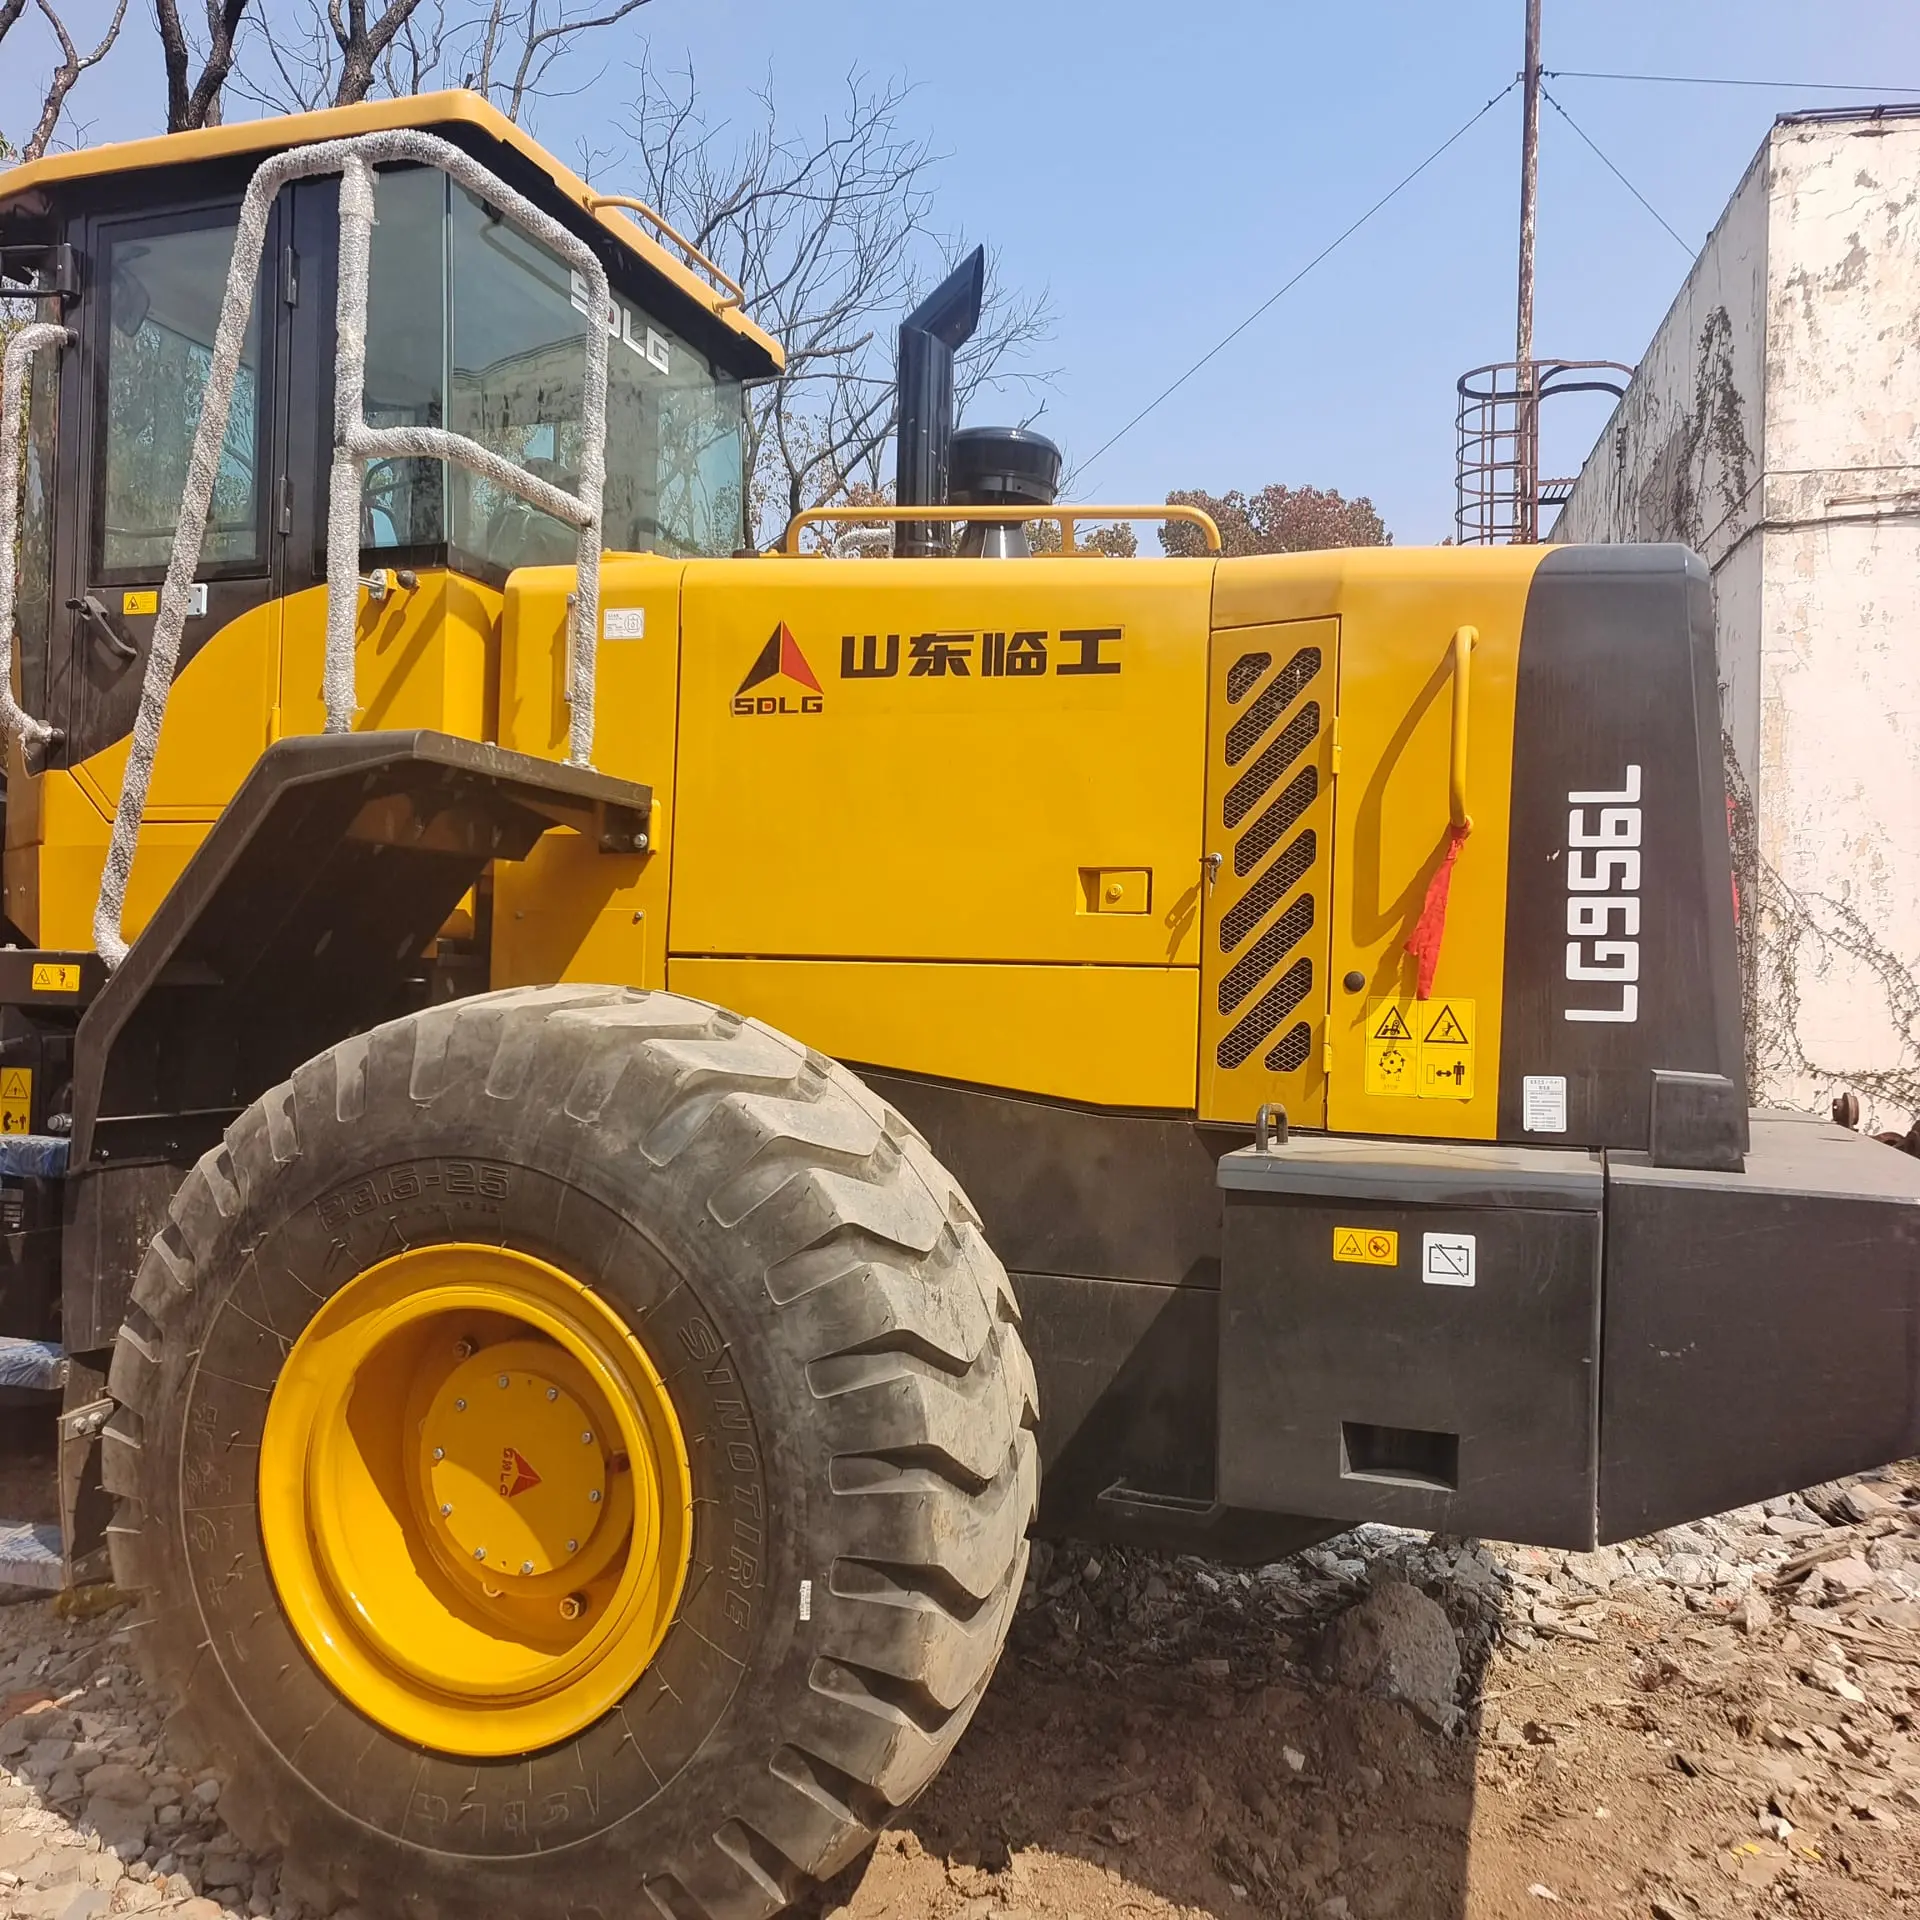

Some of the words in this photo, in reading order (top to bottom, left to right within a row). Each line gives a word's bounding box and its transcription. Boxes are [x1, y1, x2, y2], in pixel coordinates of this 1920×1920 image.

[840, 628, 1122, 679] 山东临工
[734, 696, 823, 715] SDLG
[1564, 765, 1642, 1022] LG956L
[315, 1162, 509, 1232] 23.5-25
[677, 1316, 764, 1630] SINOTIRE
